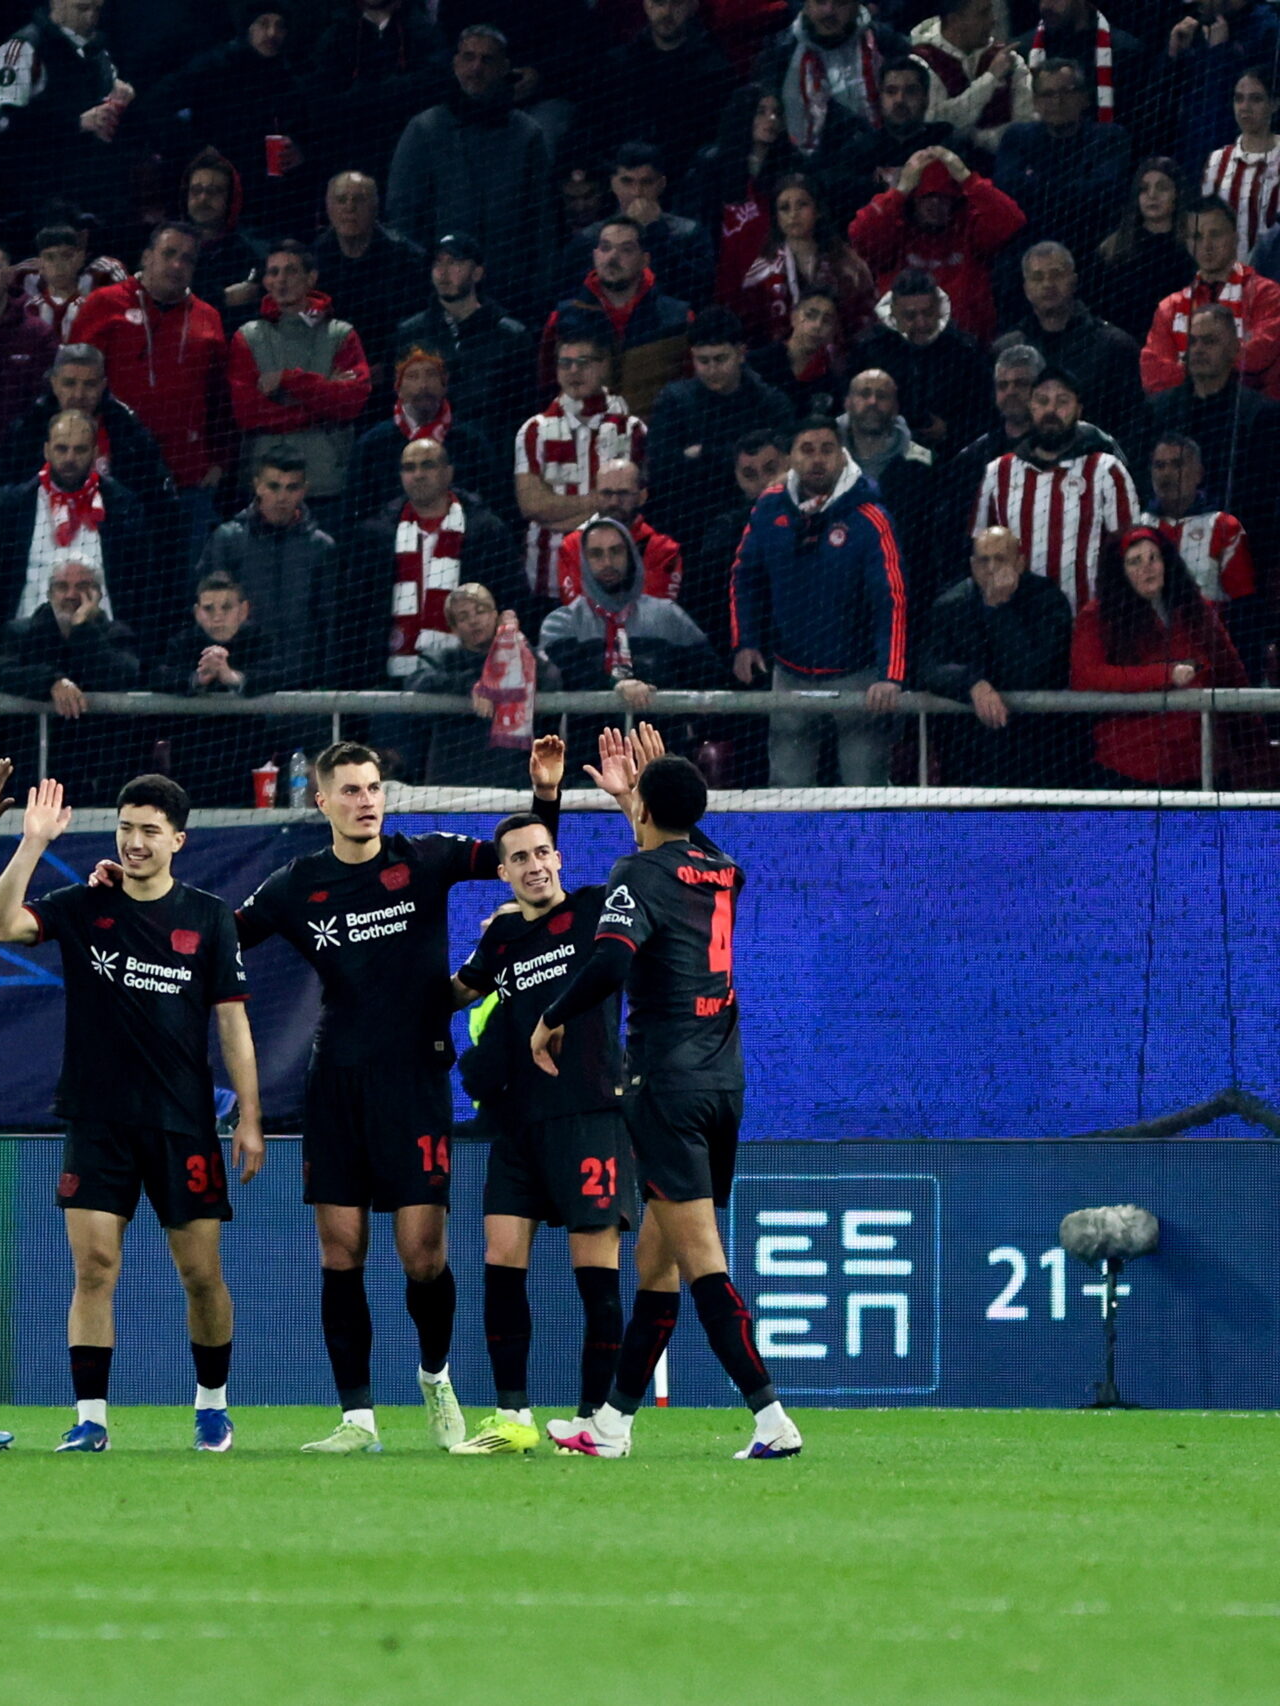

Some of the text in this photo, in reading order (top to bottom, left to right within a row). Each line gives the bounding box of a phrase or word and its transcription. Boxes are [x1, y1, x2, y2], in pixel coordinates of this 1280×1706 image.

[345, 901, 416, 927] Barmenia
[348, 920, 408, 943] Gothaer
[125, 956, 192, 981] Barmenia
[512, 944, 576, 976] Barmenia
[123, 972, 183, 994] Gothaer
[516, 963, 569, 991] Gothaer
[417, 1135, 449, 1173] 14
[580, 1157, 616, 1196] 21
[985, 1246, 1131, 1321] 21+
